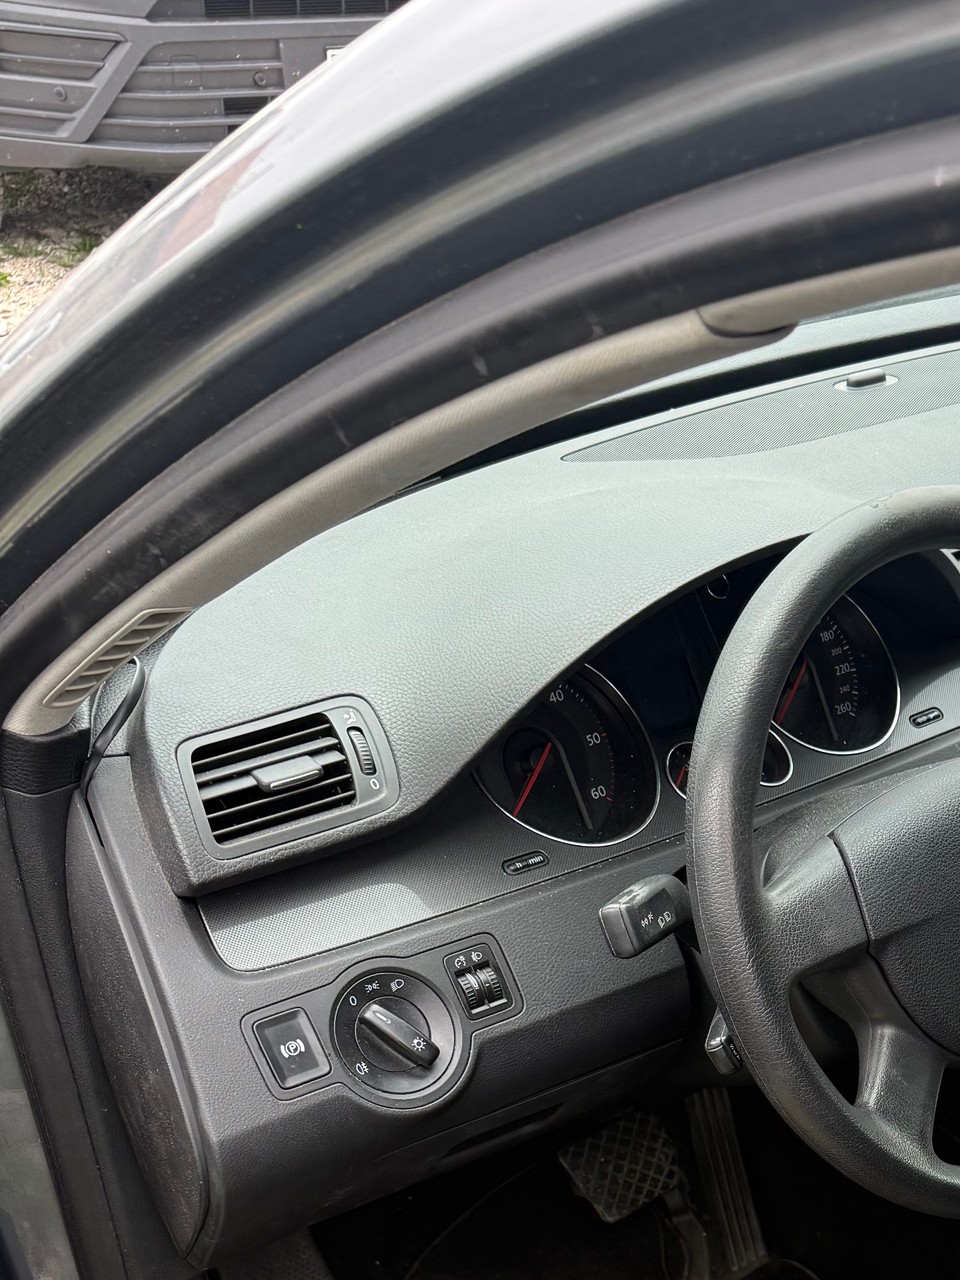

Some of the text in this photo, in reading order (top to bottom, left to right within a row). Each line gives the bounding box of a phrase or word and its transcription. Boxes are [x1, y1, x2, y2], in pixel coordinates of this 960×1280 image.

[820, 629, 835, 642] 180
[831, 647, 843, 656] 200
[834, 662, 851, 676] 220
[549, 689, 565, 703] 40
[839, 684, 851, 694] 240
[834, 701, 852, 715] 260
[586, 732, 601, 746] 50
[590, 785, 607, 800] 60
